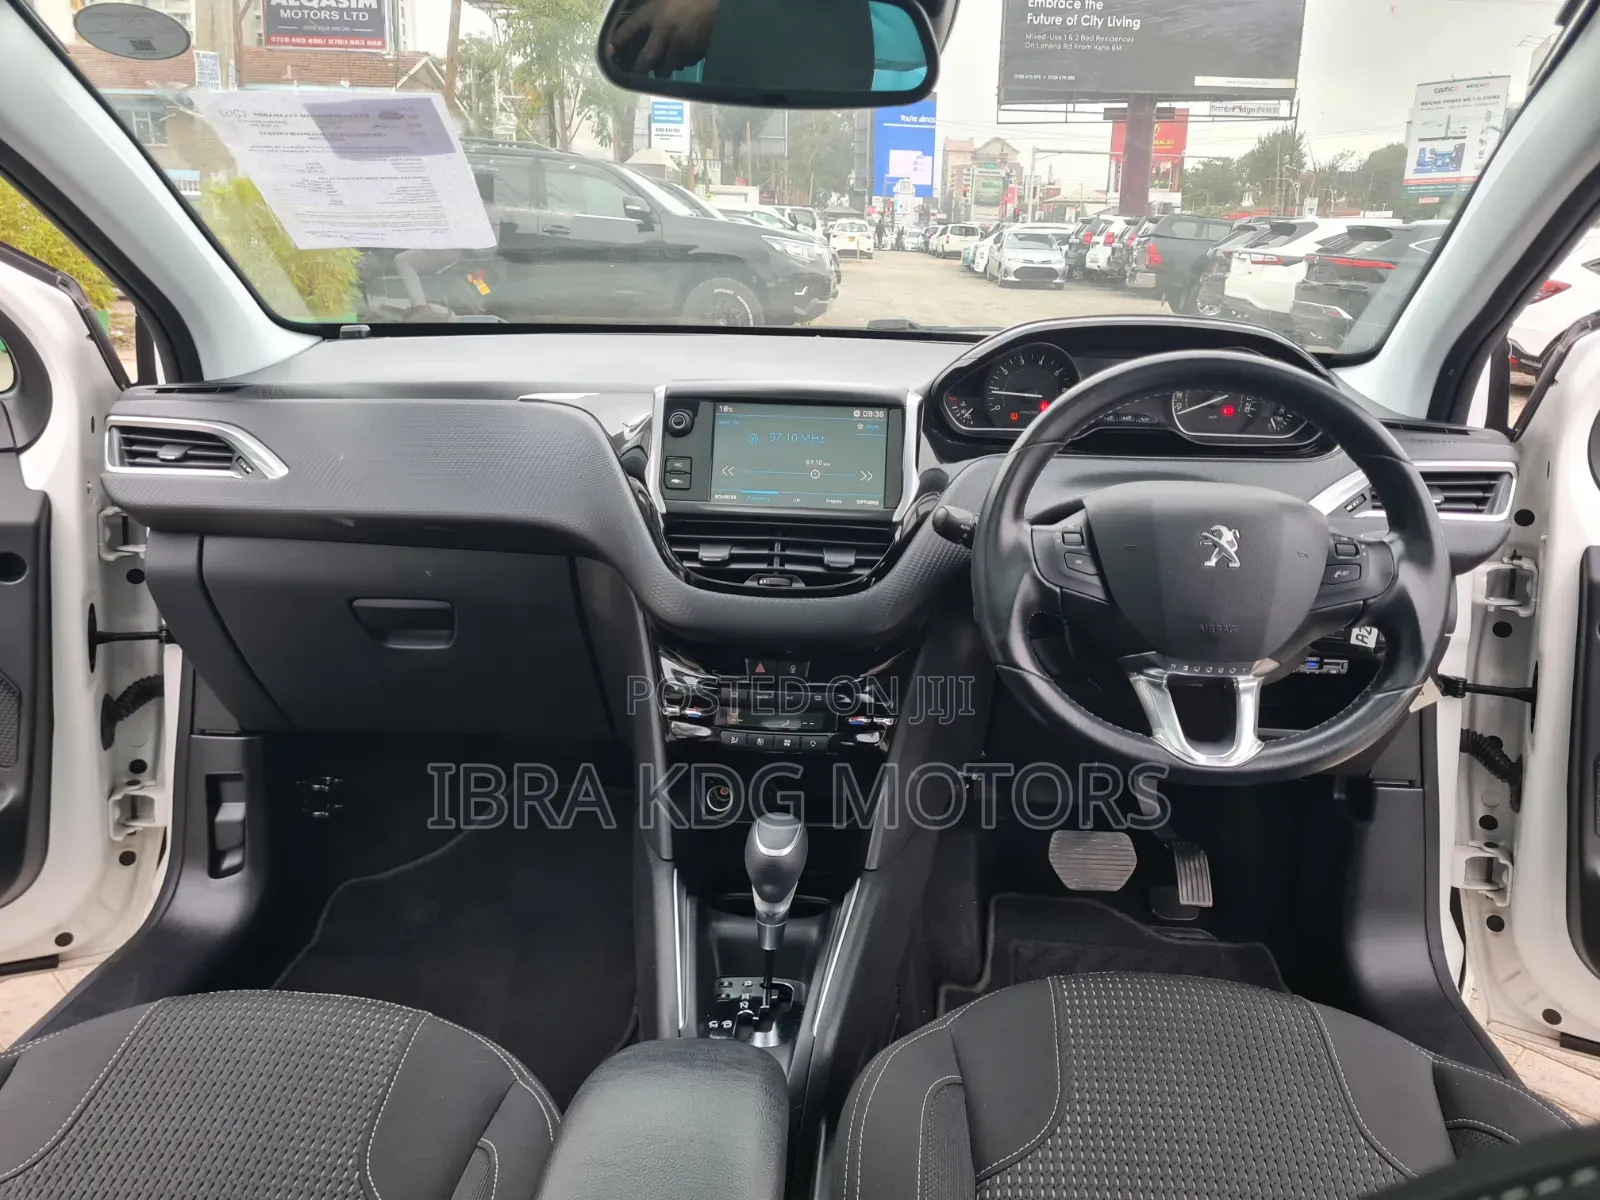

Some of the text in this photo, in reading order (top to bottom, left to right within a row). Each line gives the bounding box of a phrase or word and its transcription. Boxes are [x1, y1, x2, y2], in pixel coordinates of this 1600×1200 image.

[1028, 0, 1104, 10] Embrace the
[280, 9, 369, 21] MOTORS LTD
[1027, 13, 1141, 31] Future of City Living
[1025, 33, 1063, 41] Mixed-Use
[1081, 34, 1095, 42] Bed
[1096, 35, 1135, 43] Residences
[1063, 42, 1073, 50] Rd
[801, 433, 825, 444] MHz
[1200, 623, 1237, 634] AIRBAG
